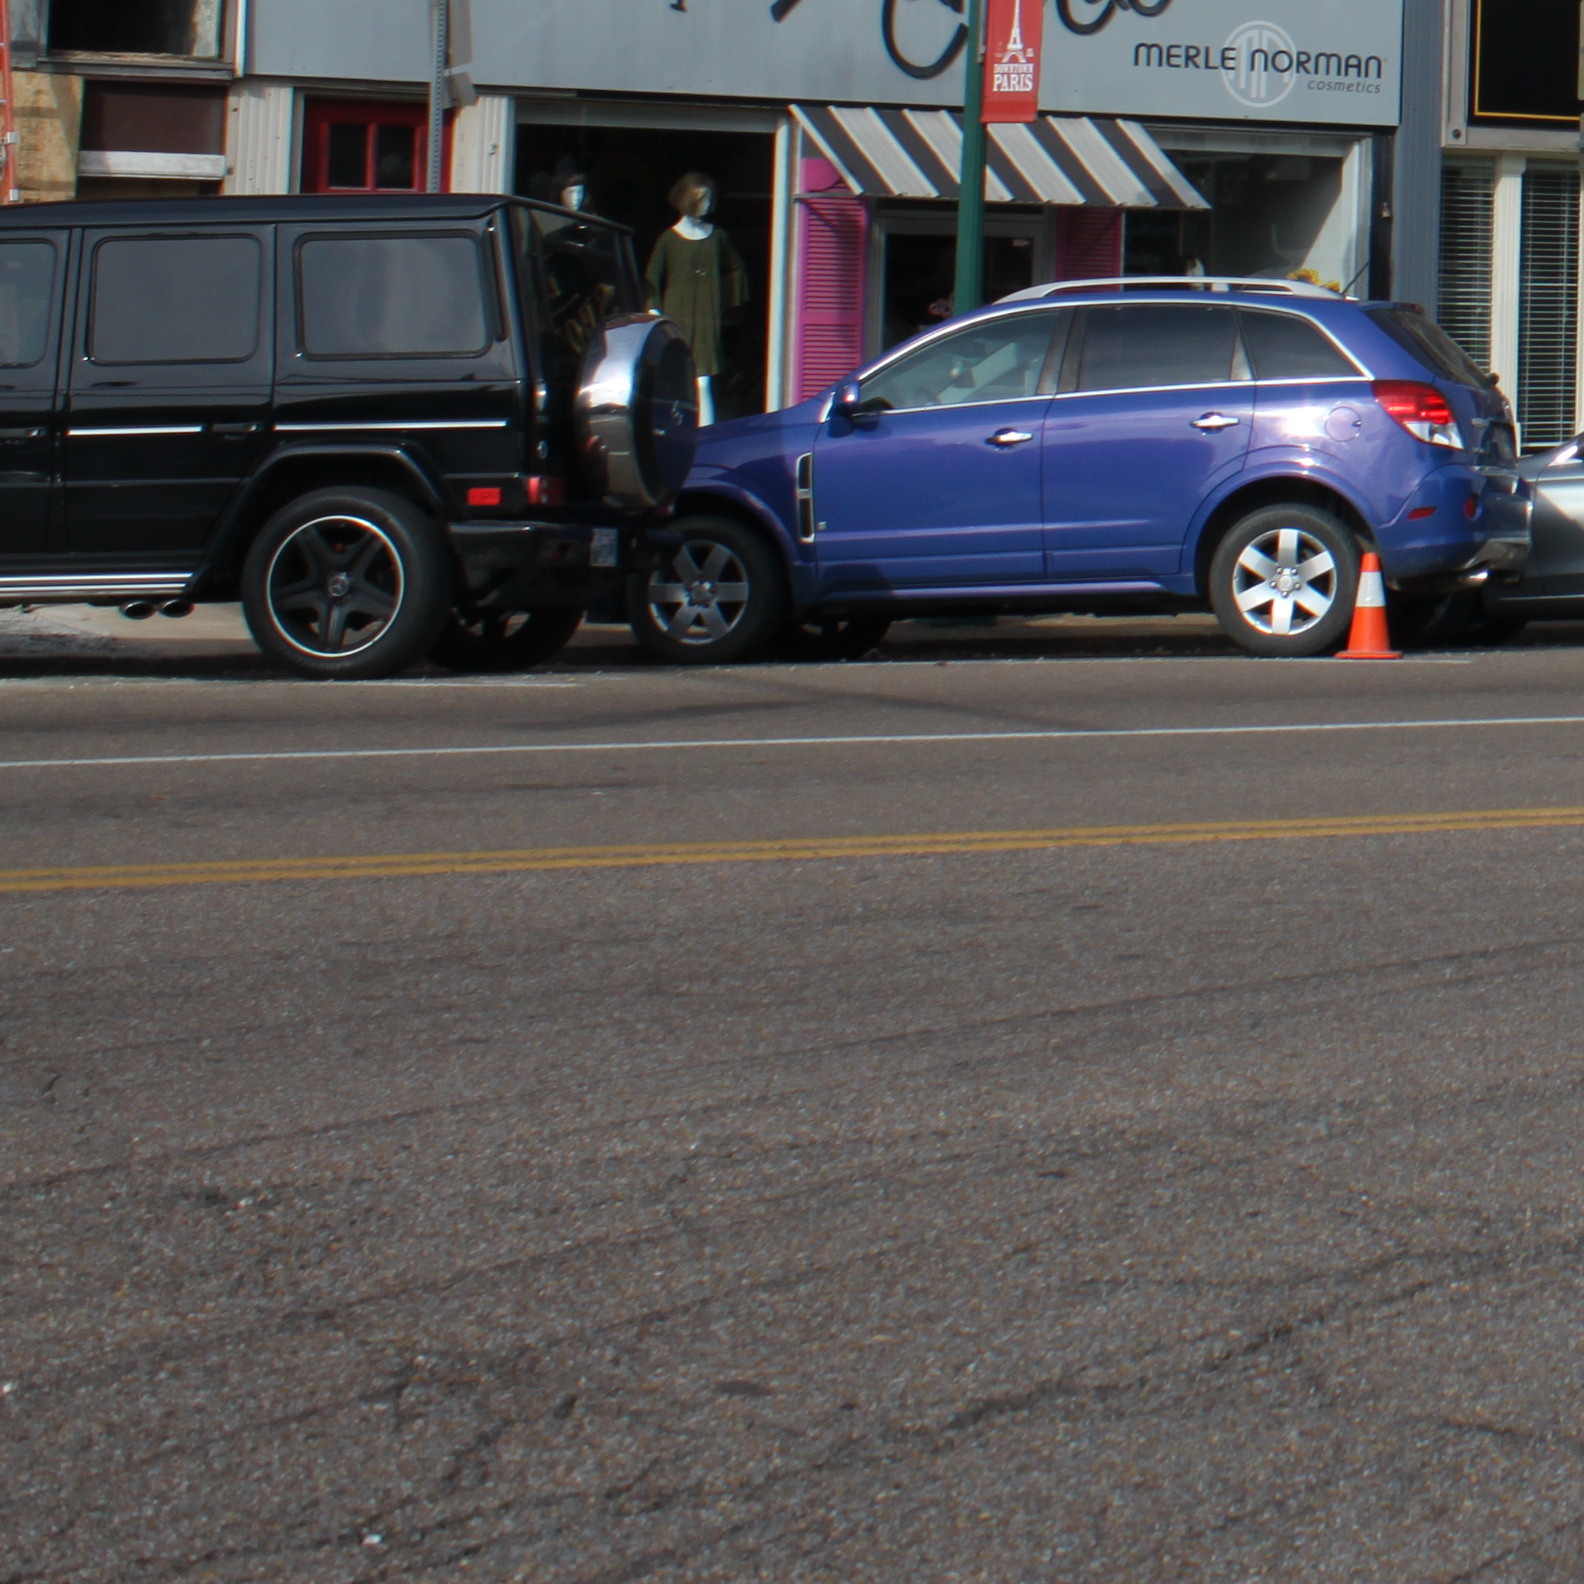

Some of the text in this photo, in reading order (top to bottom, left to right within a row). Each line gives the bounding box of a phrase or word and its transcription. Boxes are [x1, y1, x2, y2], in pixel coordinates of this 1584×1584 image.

[1133, 42, 1237, 71] MERLE
[1250, 48, 1383, 80] NORMAN
[992, 73, 1033, 92] PARIS
[1307, 79, 1382, 95] cosmetics
